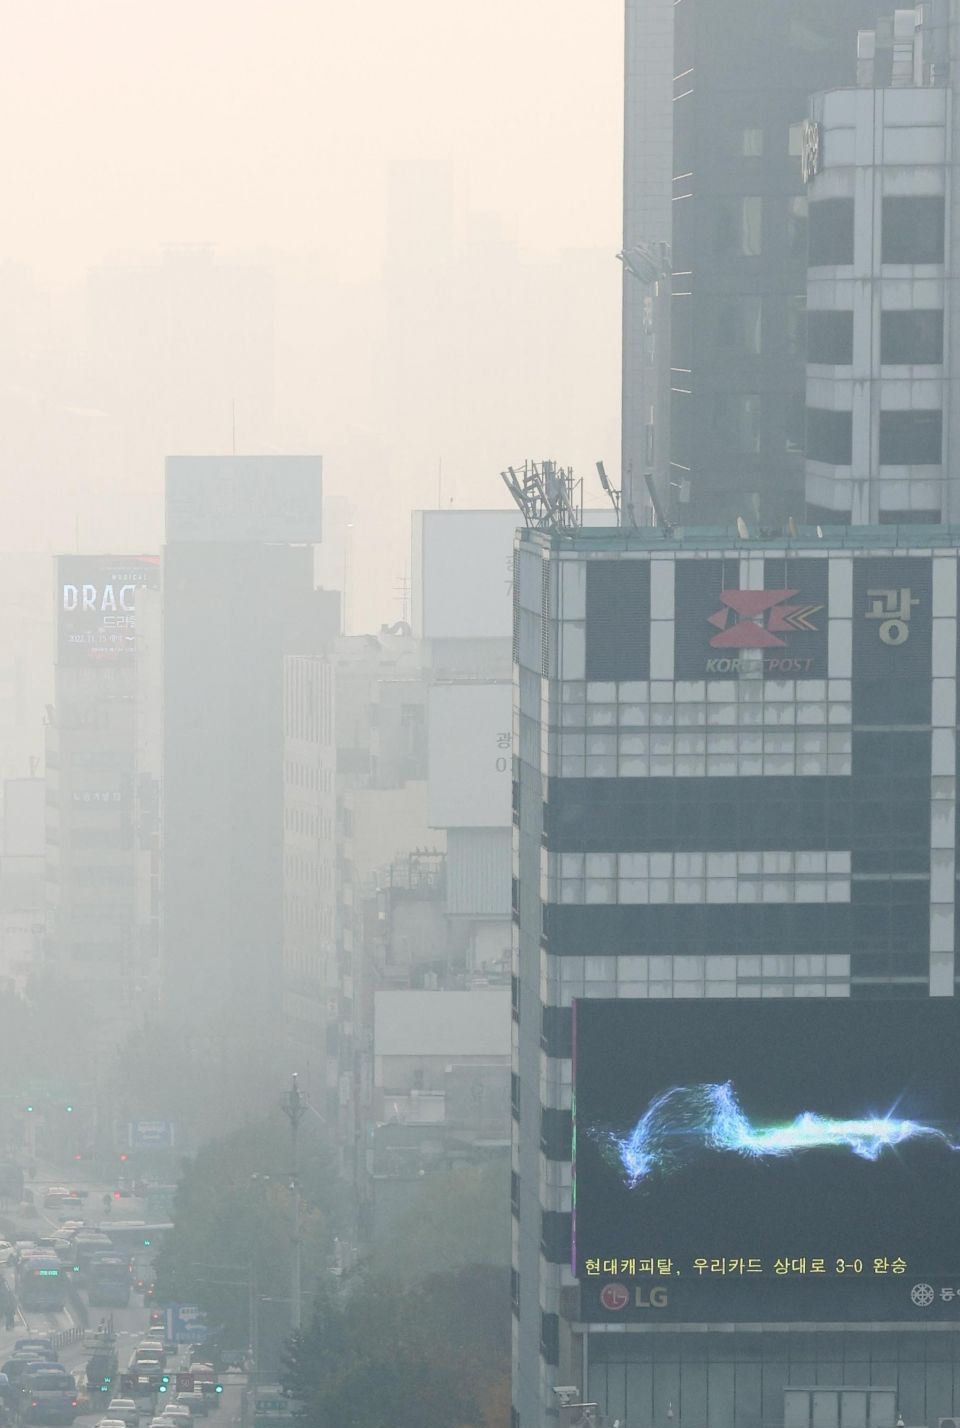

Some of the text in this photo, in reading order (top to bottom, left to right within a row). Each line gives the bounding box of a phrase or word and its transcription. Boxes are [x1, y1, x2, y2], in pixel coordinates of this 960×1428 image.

[864, 587, 921, 646] 광
[767, 657, 815, 673] POST
[584, 1256, 908, 1276] 현대캐피탈, 우리카드 상대로 3-0 완승
[634, 1285, 669, 1309] LG
